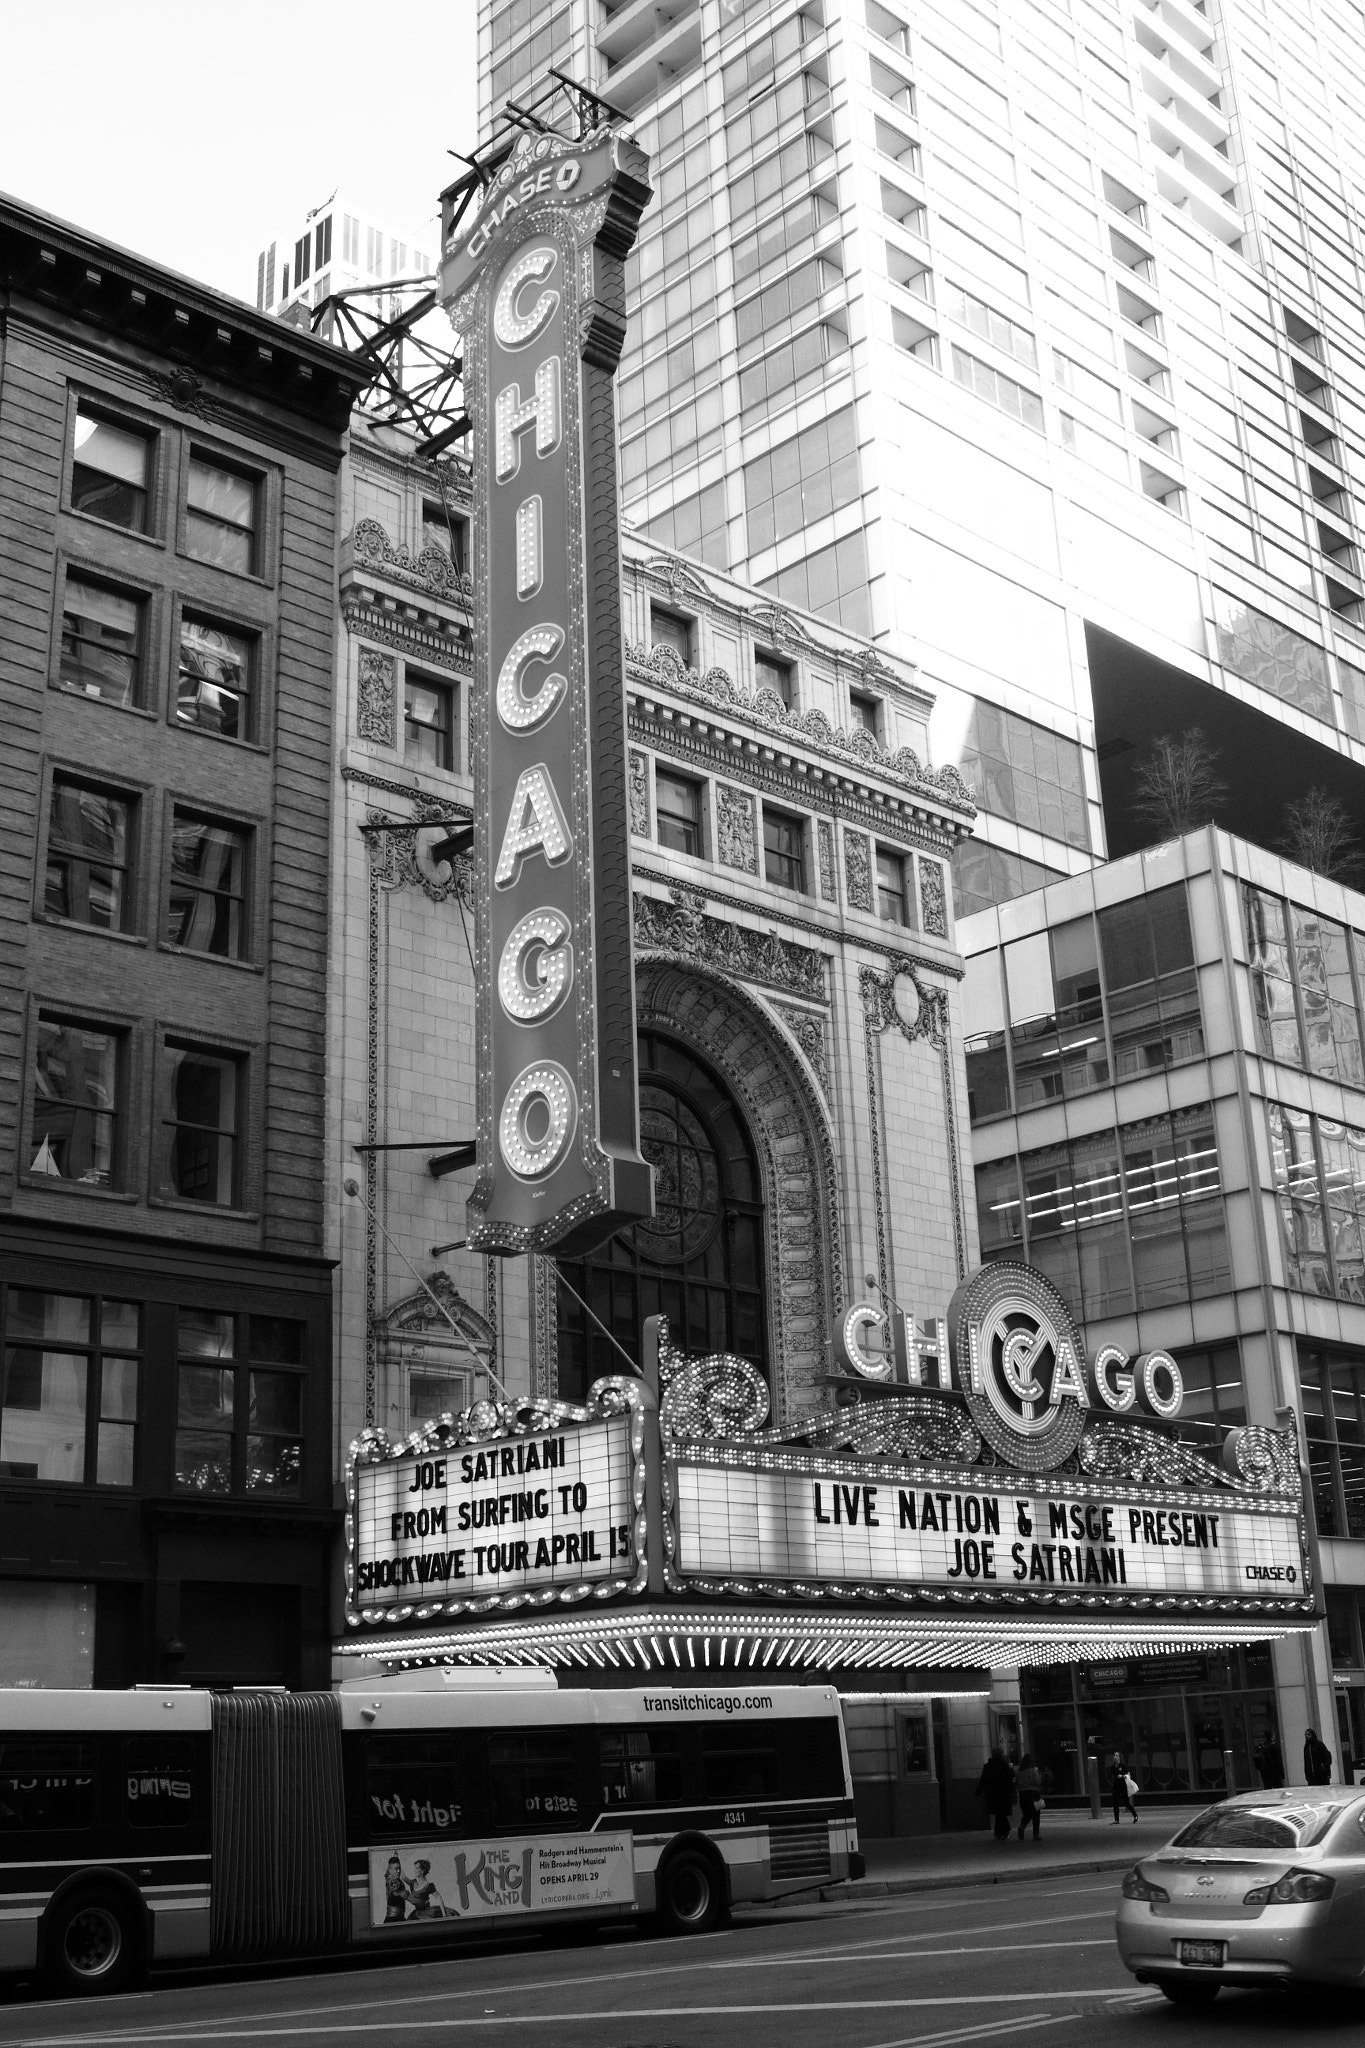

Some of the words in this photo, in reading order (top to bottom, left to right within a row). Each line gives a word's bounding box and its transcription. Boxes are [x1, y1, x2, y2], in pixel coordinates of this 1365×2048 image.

[466, 166, 553, 258] CHASE
[493, 247, 578, 1184] CHICAGO
[838, 1300, 1184, 1418] CHICAGO
[408, 1459, 448, 1492] JOE
[460, 1437, 566, 1484] SATRIANI
[391, 1505, 448, 1541] FROM
[457, 1488, 549, 1531] SURFING
[558, 1482, 588, 1515] TO
[814, 1482, 880, 1527] LIVE
[899, 1489, 1001, 1536] NATION
[1016, 1500, 1033, 1537] &
[1050, 1501, 1116, 1543] MSGE
[1128, 1508, 1220, 1549] PRESENT
[357, 1549, 467, 1591] SHOCKWAVE
[473, 1540, 529, 1576] TOUR
[534, 1530, 601, 1570] APRIL
[609, 1525, 630, 1558] 15
[947, 1538, 997, 1579] JOE
[1012, 1542, 1127, 1585] SATRIANI
[1246, 1565, 1286, 1581] CHASE
[1094, 1669, 1124, 1678] CHICAGO
[643, 1694, 773, 1713] transitchicago.com
[724, 1811, 746, 1825] 4341
[486, 1850, 510, 1864] THE
[539, 1848, 565, 1859] Rodgers
[566, 1846, 578, 1856] and
[579, 1843, 624, 1855] Hammerstein's
[539, 1860, 550, 1870] Hit
[551, 1859, 581, 1869] Broadway
[582, 1856, 607, 1866] Musical
[454, 1850, 523, 1910] KING
[540, 1875, 566, 1885] OPENS
[567, 1873, 588, 1883] APRIL
[589, 1872, 599, 1881] 29
[494, 1891, 520, 1907] AND
